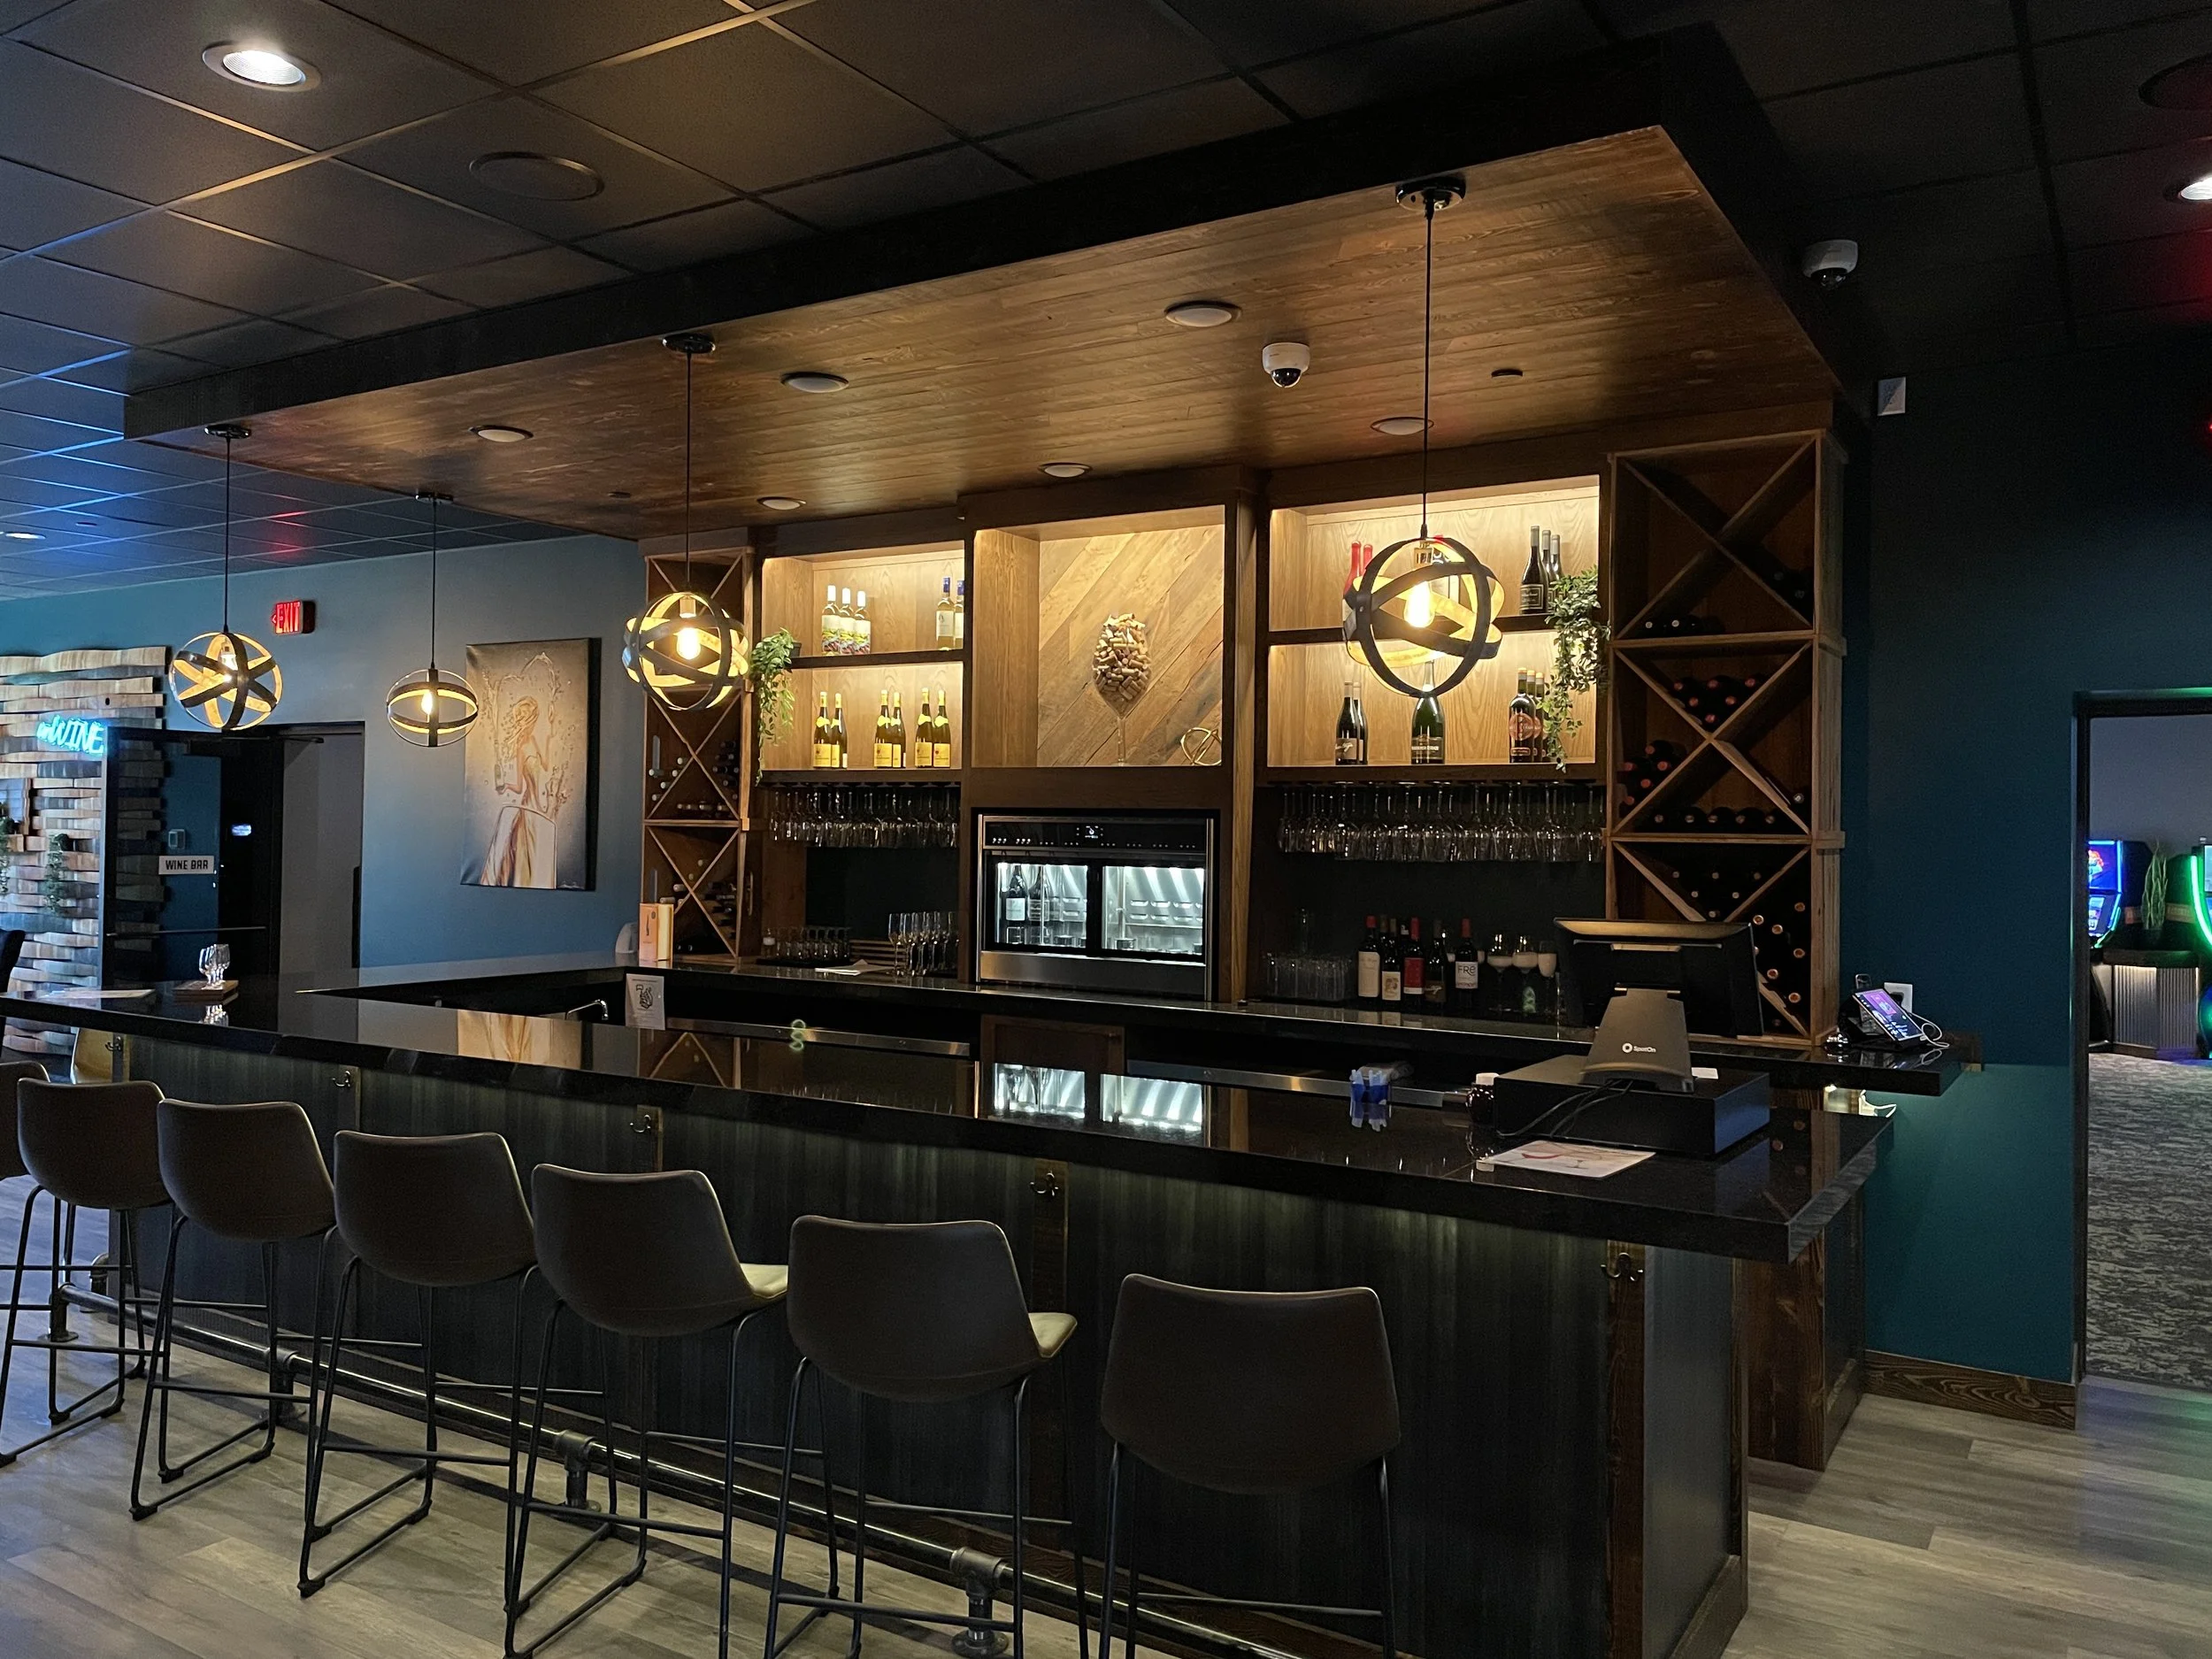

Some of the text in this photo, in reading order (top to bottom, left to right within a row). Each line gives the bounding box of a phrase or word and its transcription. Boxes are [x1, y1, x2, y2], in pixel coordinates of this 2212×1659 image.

[276, 602, 301, 634] EXIT
[165, 860, 209, 870] WINE BAR
